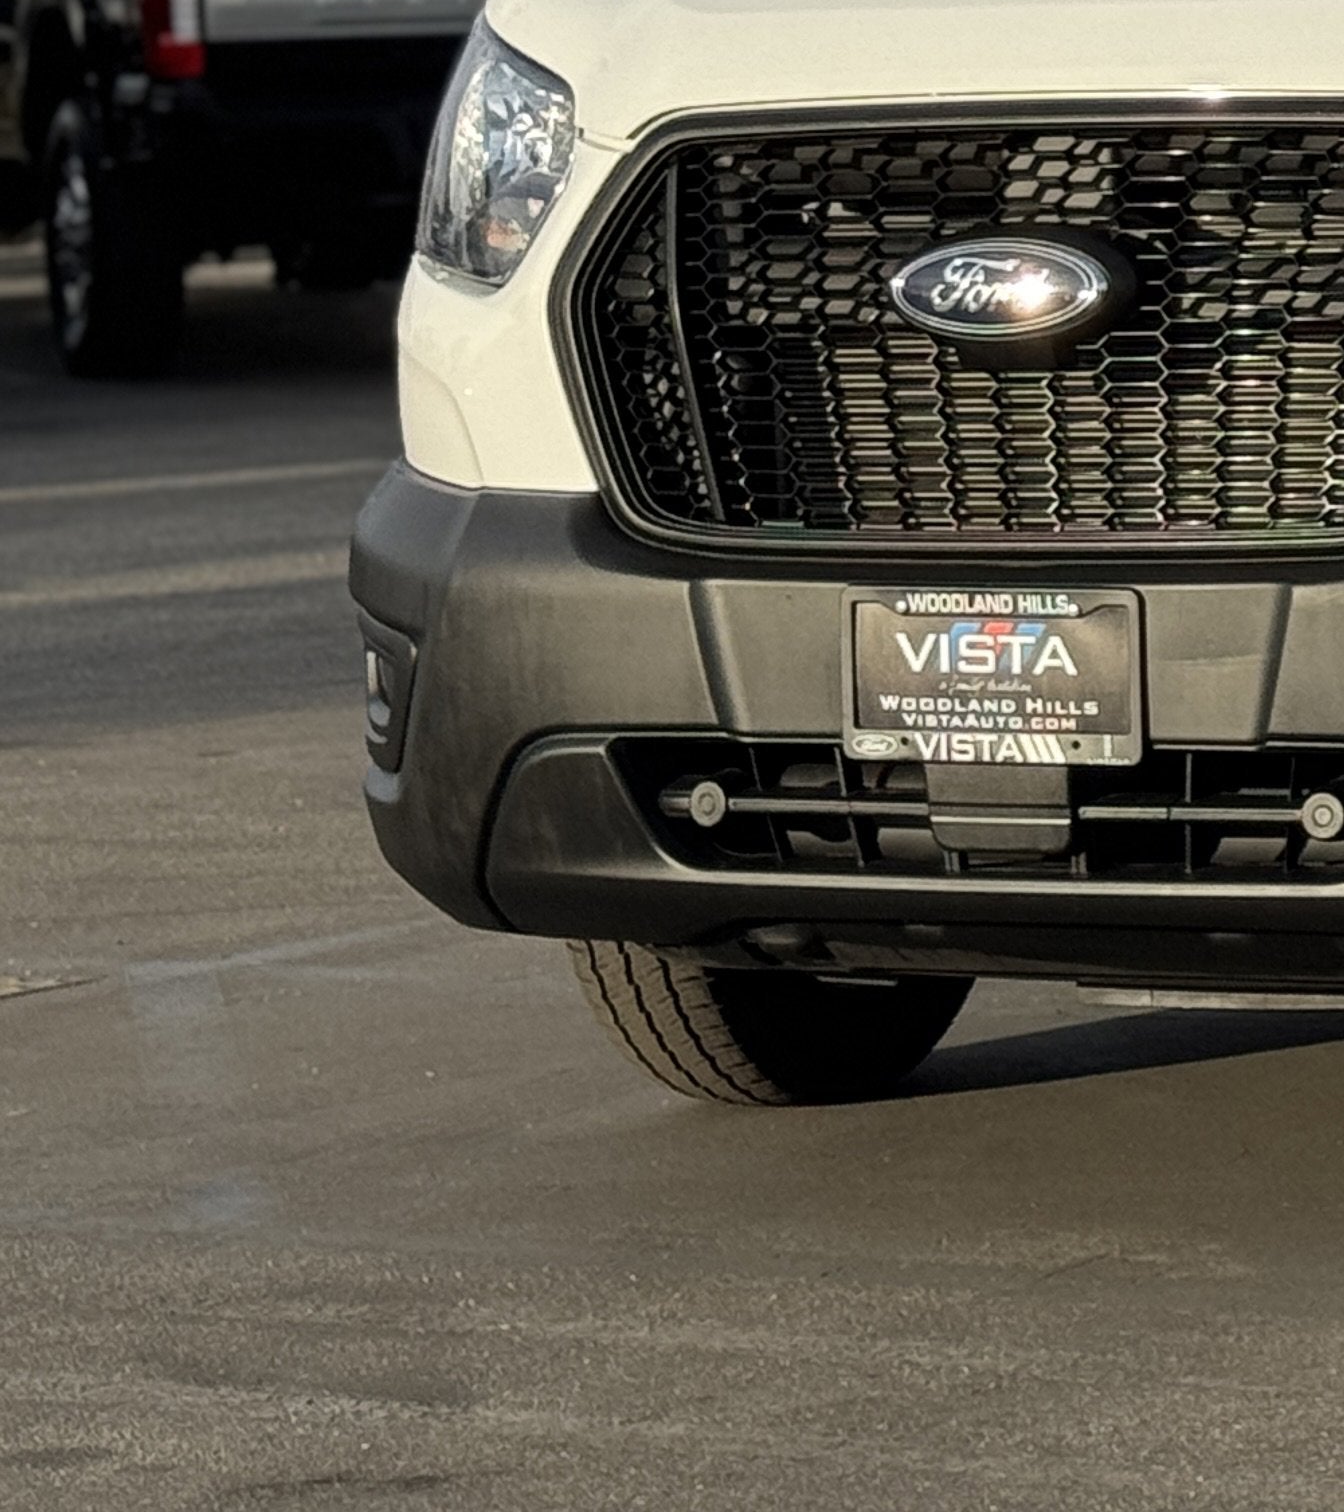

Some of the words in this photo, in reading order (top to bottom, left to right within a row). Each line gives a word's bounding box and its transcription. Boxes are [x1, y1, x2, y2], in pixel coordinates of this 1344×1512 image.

[907, 593, 1013, 614] WOODLAND
[1018, 594, 1069, 614] HILLS
[896, 633, 1078, 675] VISTA
[880, 695, 1017, 714] WOODLAND
[1026, 697, 1099, 716] HILLS
[915, 733, 1024, 763] VISTA
